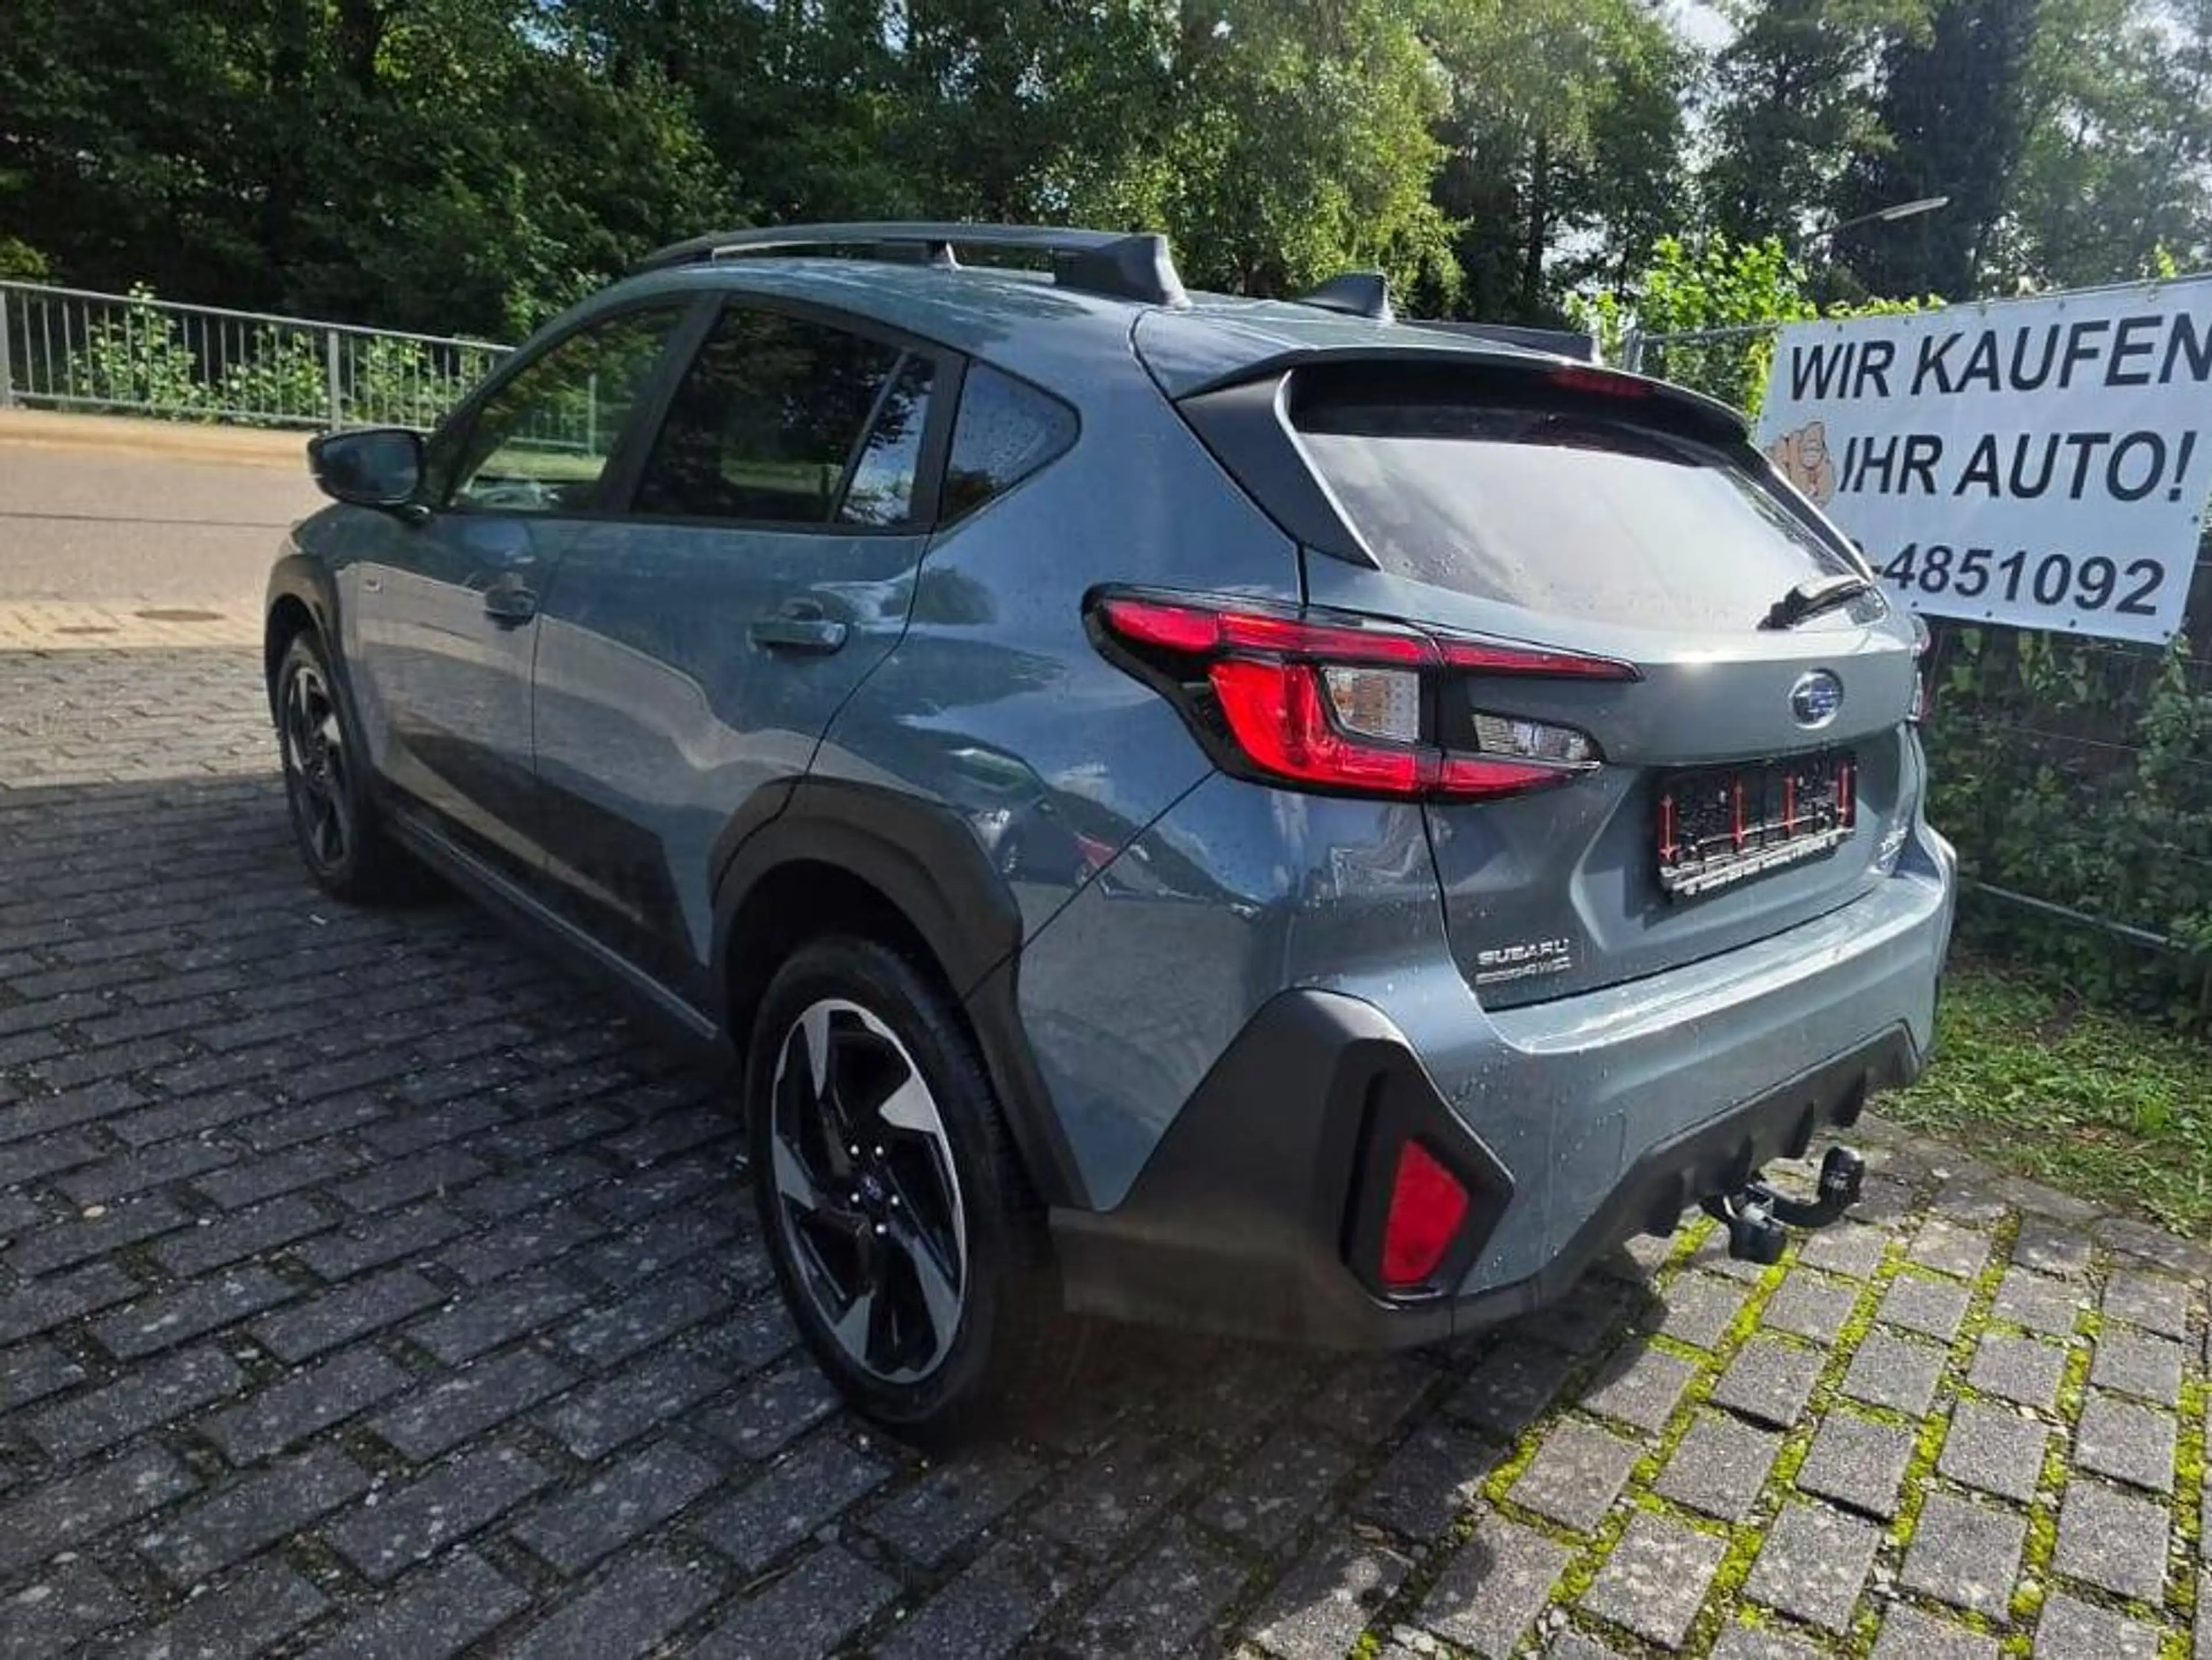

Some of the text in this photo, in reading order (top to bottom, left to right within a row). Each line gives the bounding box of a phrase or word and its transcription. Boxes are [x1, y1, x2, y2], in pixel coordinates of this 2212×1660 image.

[1791, 312, 2212, 401] WIR KAUFEN
[1838, 430, 2198, 502] IHR AUTO!
[1849, 537, 2165, 616] -4851092
[1478, 938, 1569, 965] SUBARU
